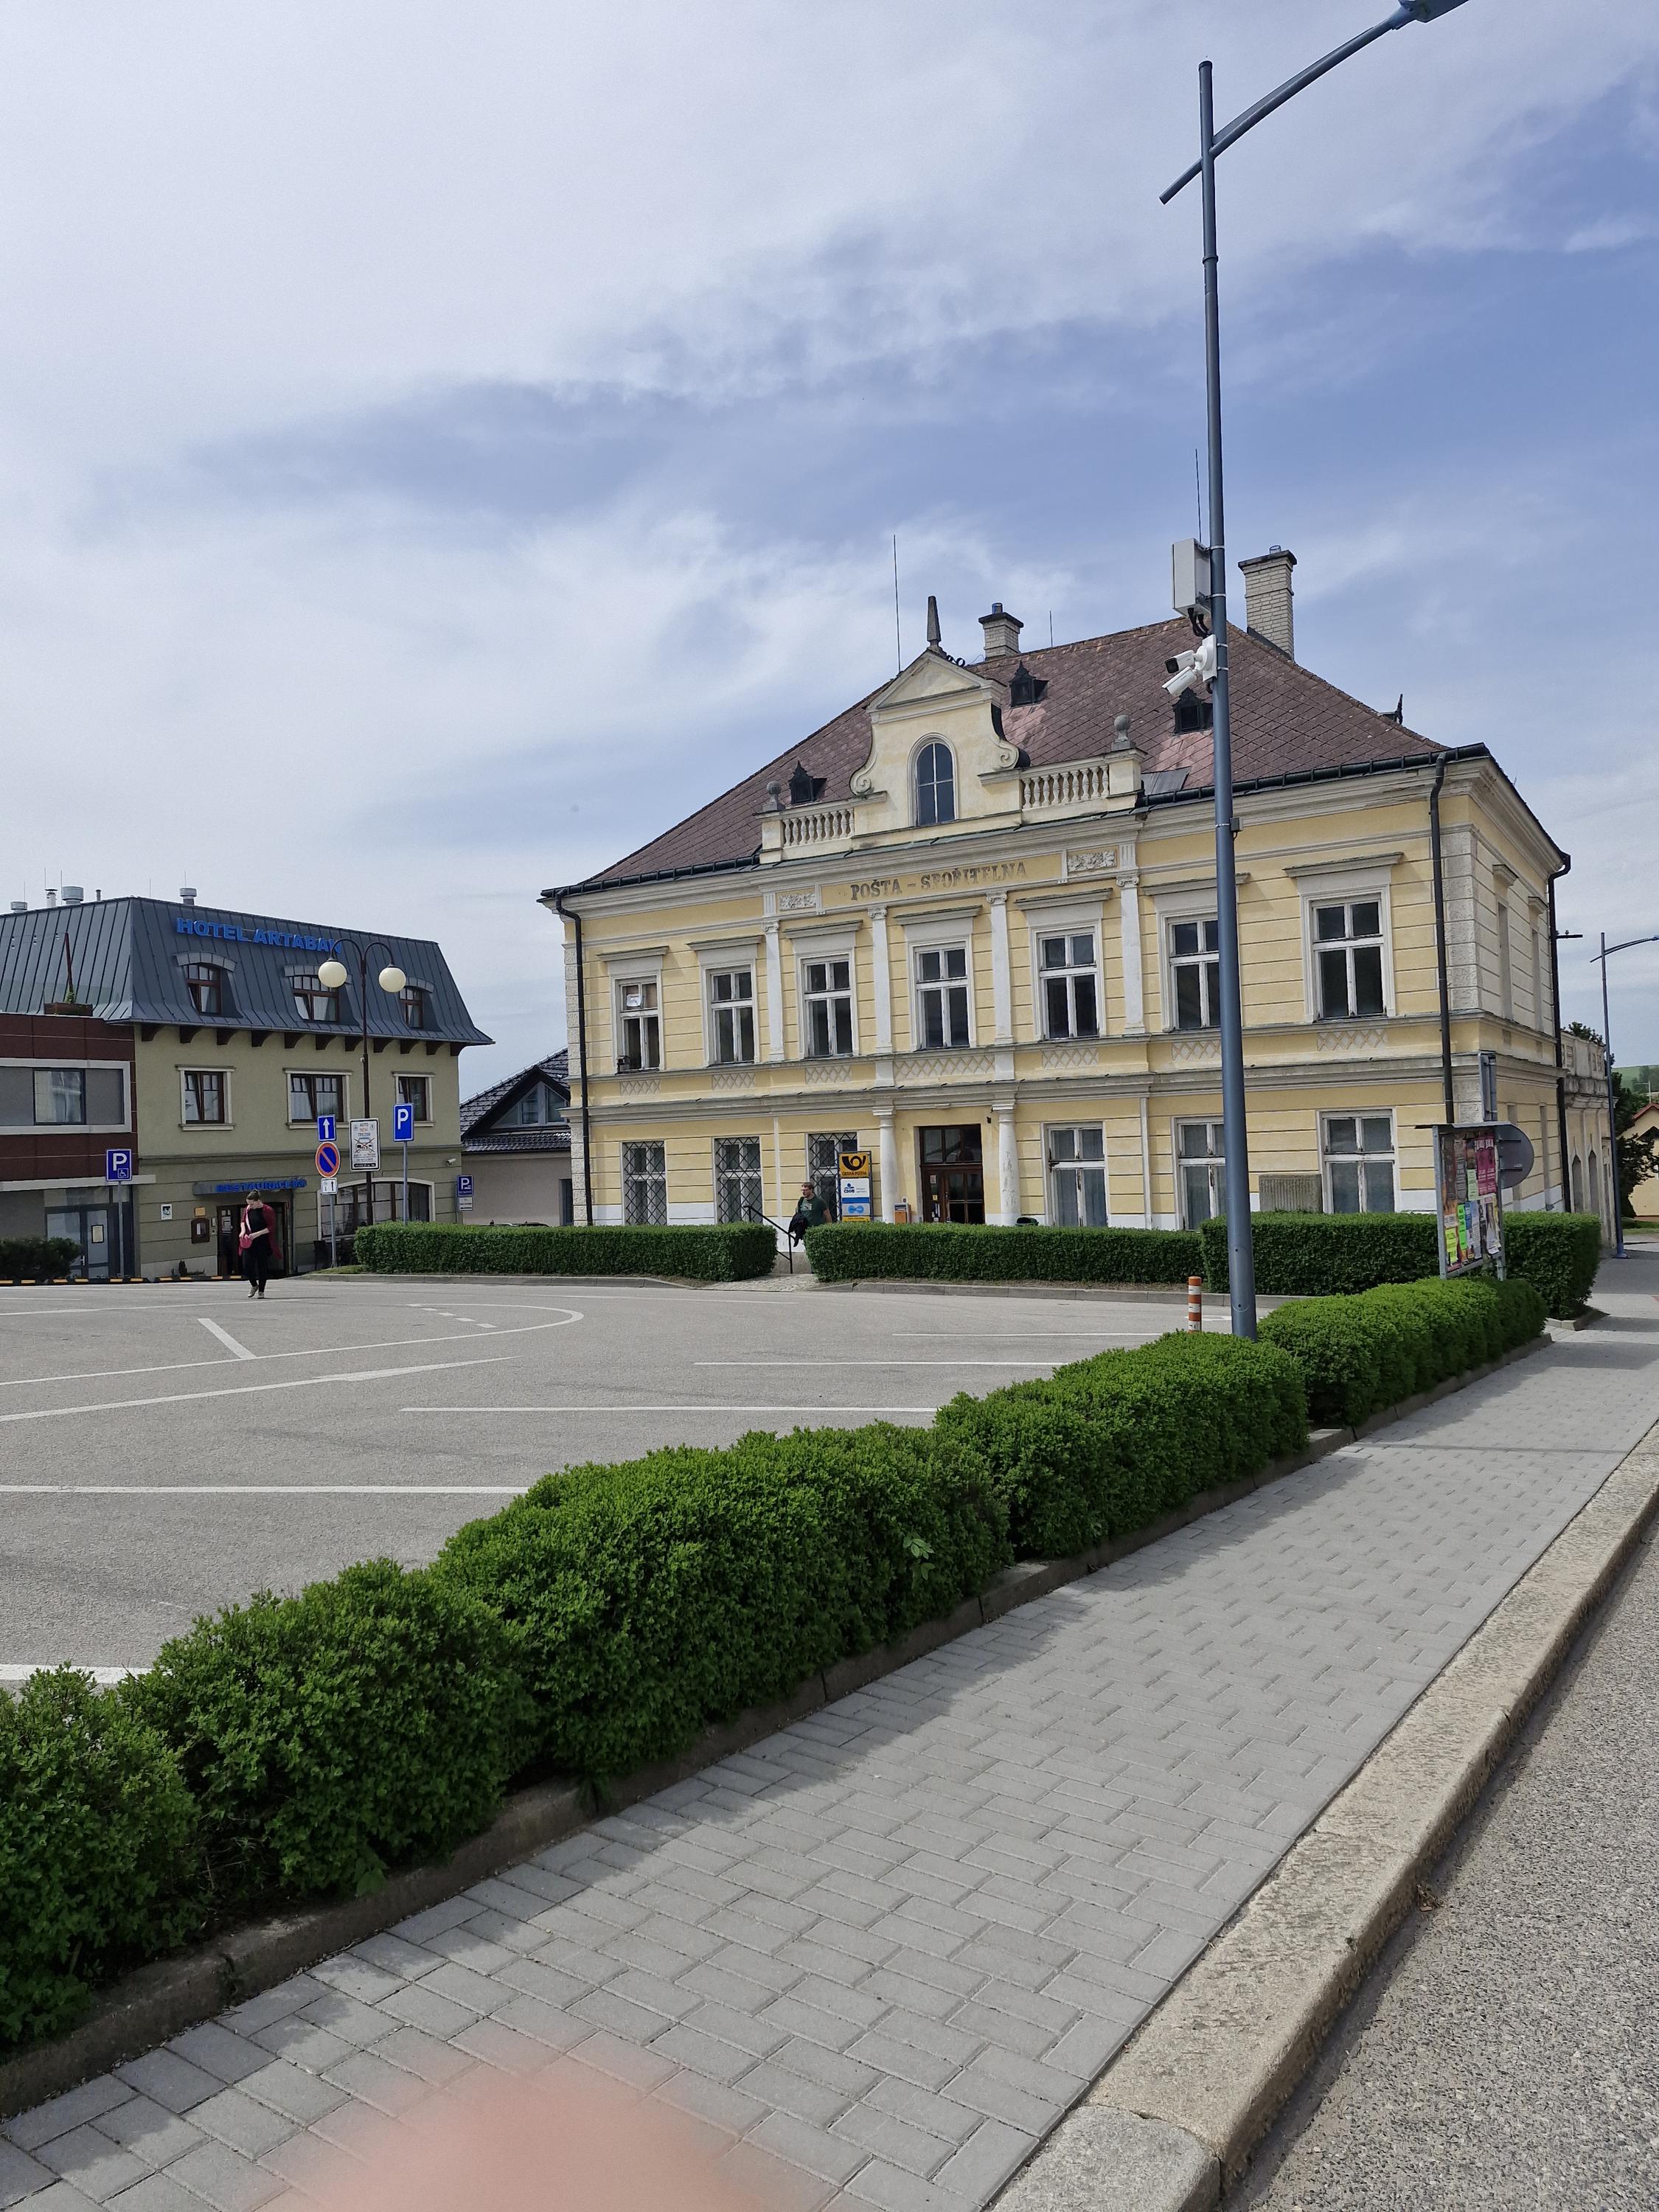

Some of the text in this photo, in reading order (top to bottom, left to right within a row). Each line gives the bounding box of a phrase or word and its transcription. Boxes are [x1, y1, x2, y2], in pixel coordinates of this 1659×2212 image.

[850, 878, 902, 900] POŠTA
[920, 861, 1027, 891] SPOŘITELNA
[176, 917, 342, 954] HOTEL ARTABAN
[398, 1108, 408, 1130] P
[113, 1152, 127, 1171] P
[461, 1178, 470, 1190] P
